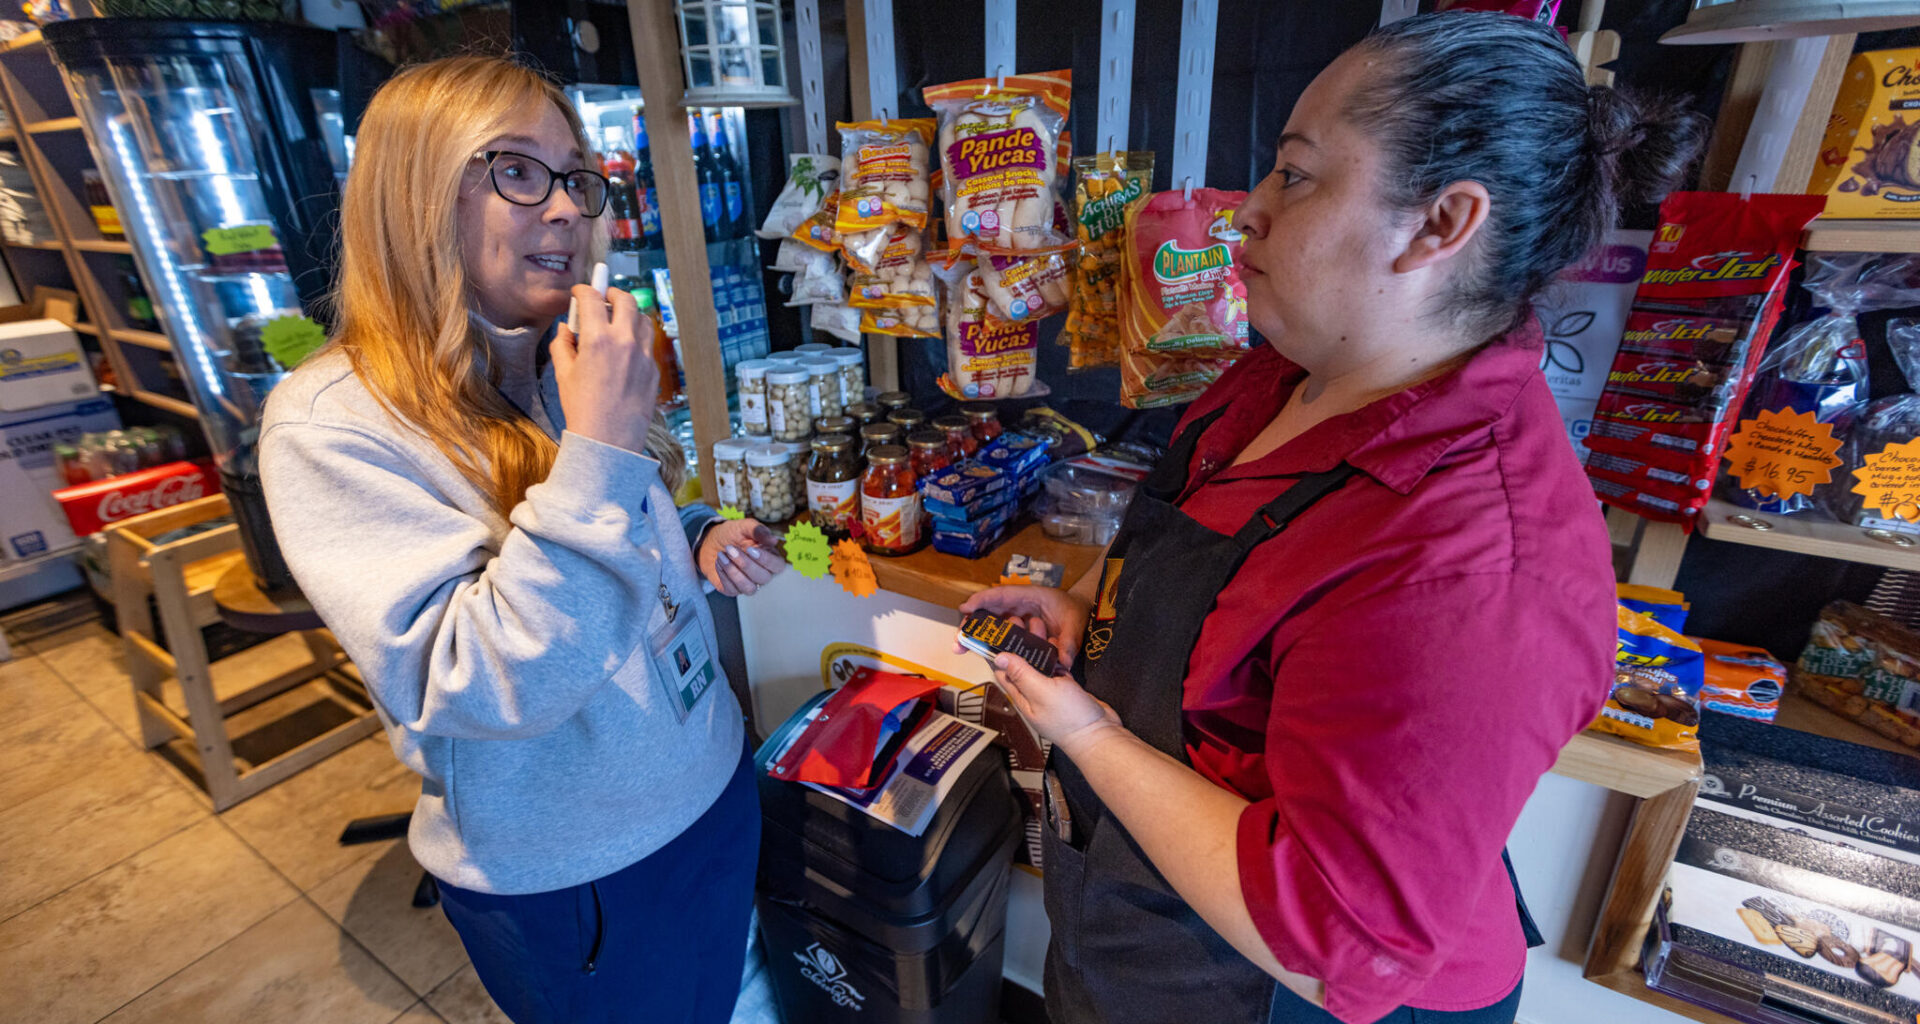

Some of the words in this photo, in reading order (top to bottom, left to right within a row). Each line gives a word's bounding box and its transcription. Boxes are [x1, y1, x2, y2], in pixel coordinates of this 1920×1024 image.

[960, 129, 1035, 160] Pande
[968, 148, 1037, 173] Yucas
[1080, 179, 1141, 221] ACHIRAS
[1661, 223, 1683, 242] 10
[1162, 247, 1225, 276] PLANTAIN
[1603, 256, 1632, 273] US
[974, 333, 1031, 354] Yucas
[689, 667, 708, 699] RN
[1739, 783, 1798, 811] Premium
[1799, 803, 1866, 829] Assorted
[1866, 816, 1920, 843] Cookies
